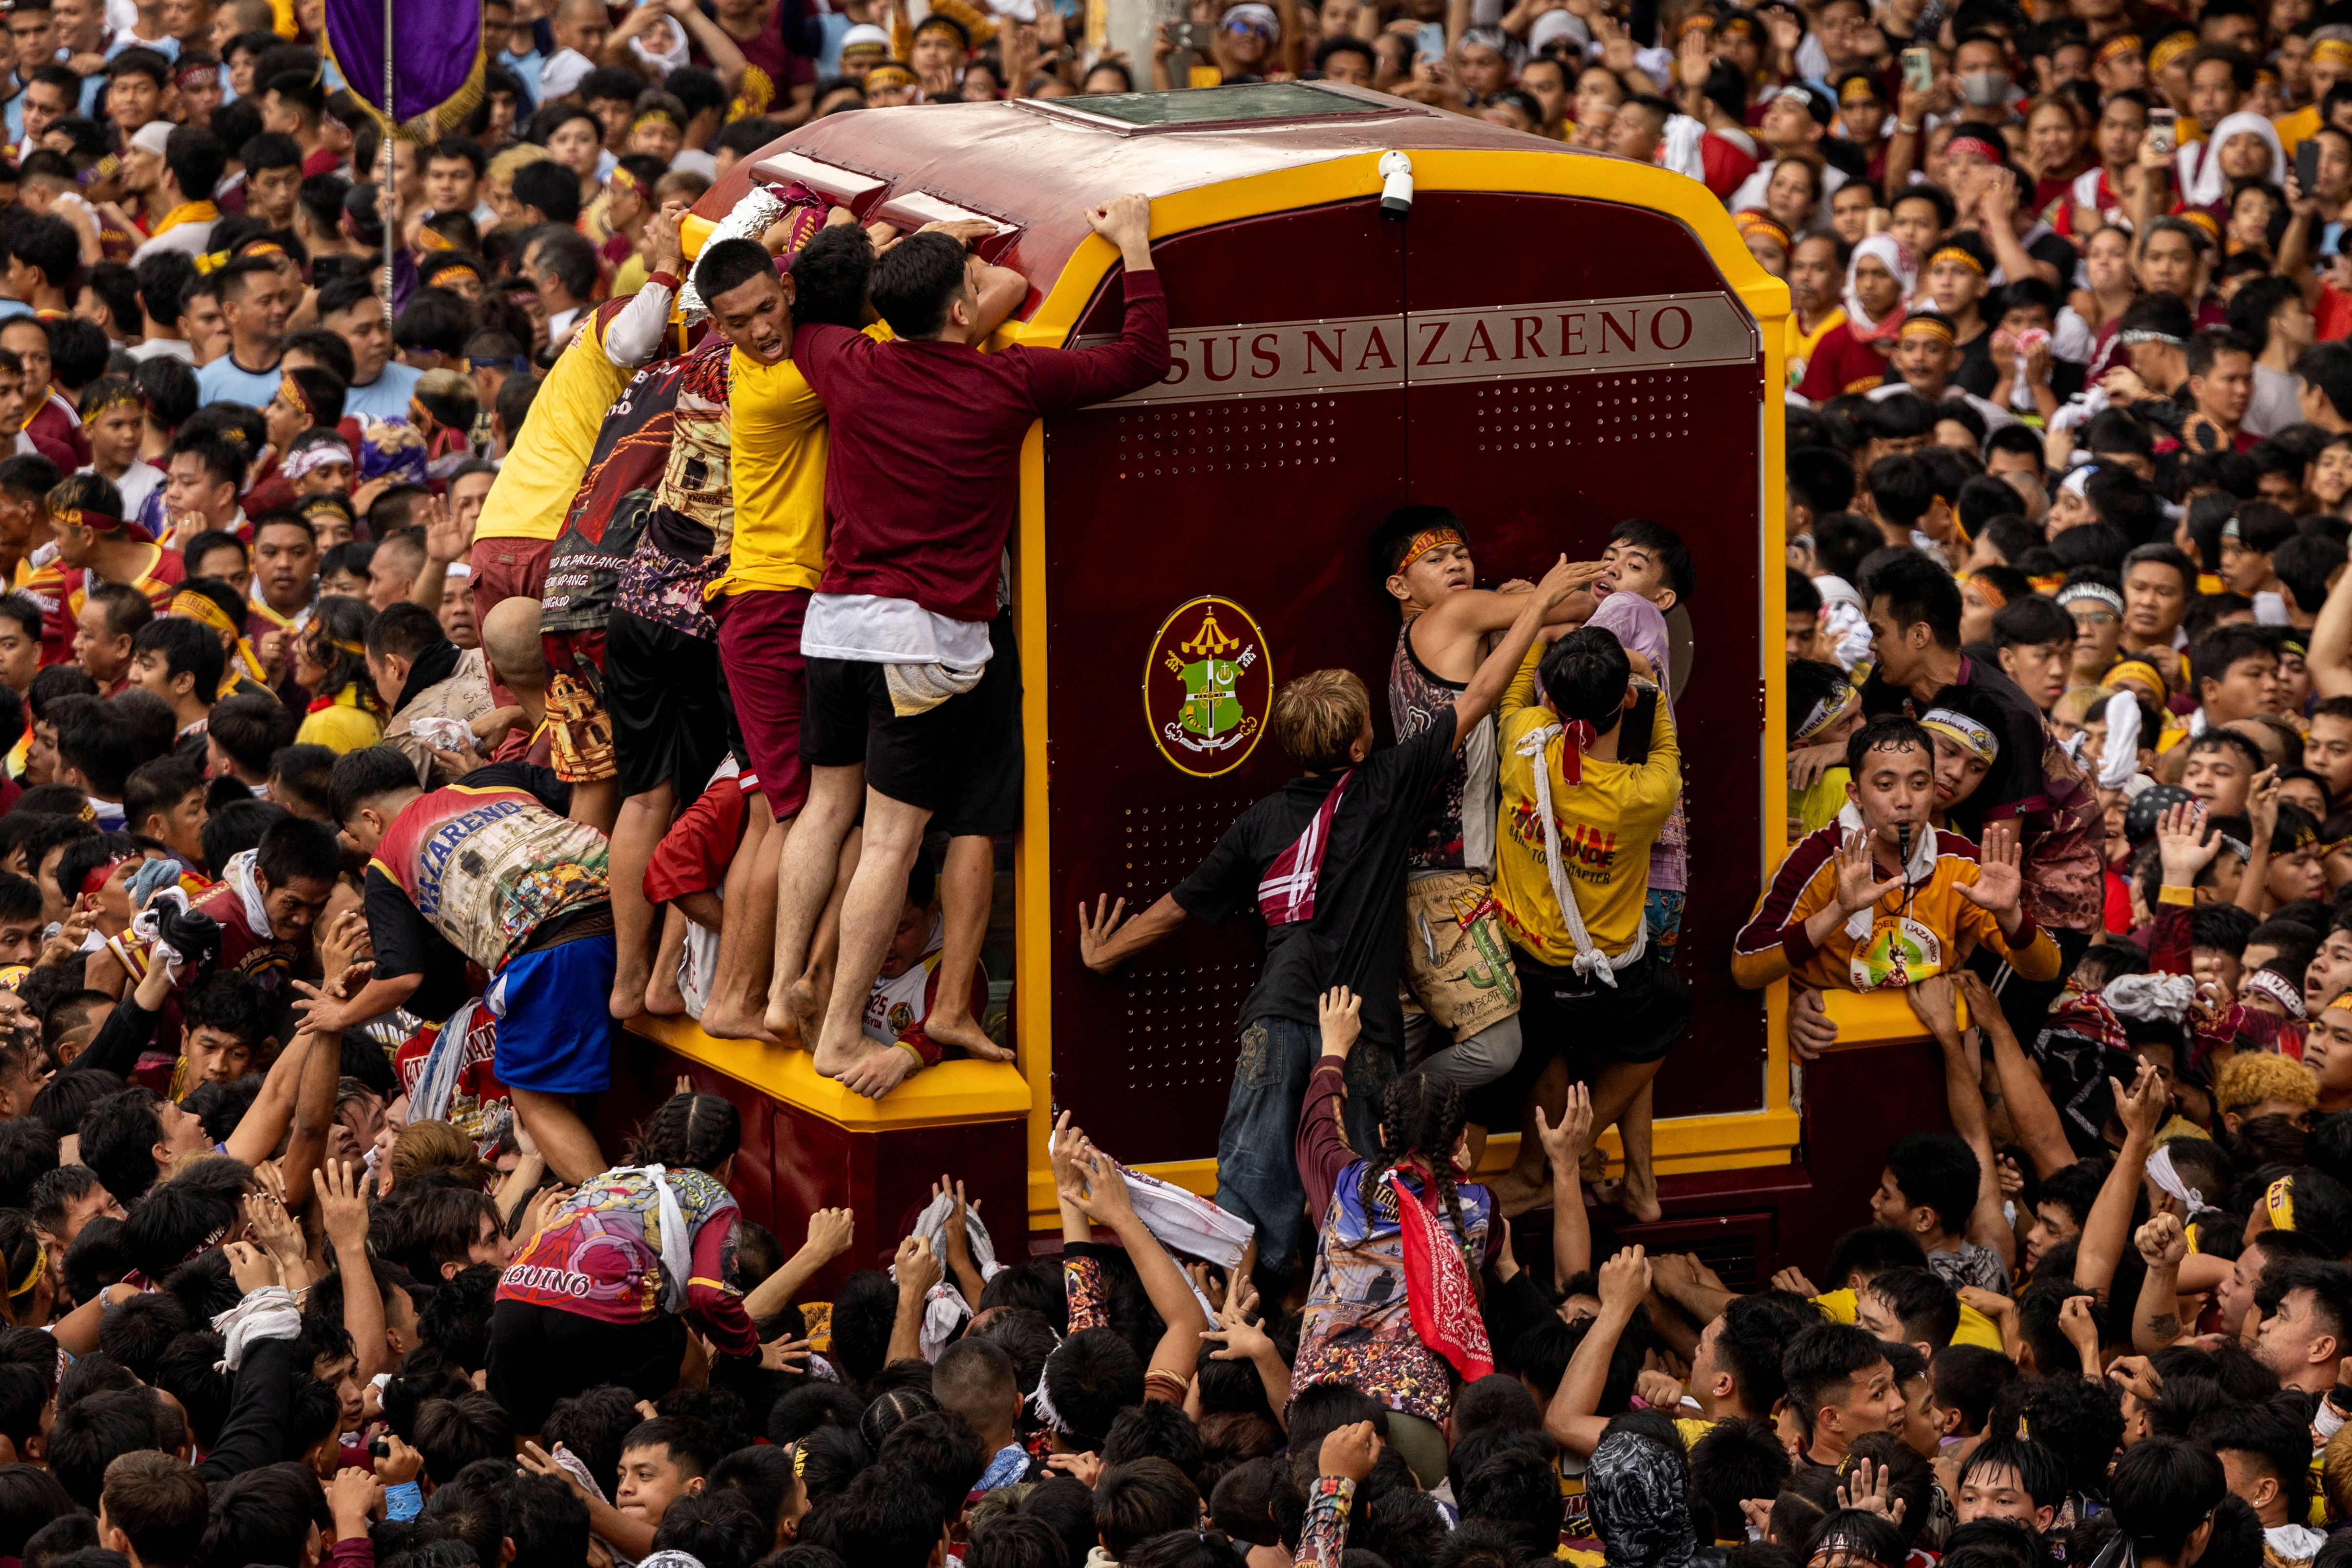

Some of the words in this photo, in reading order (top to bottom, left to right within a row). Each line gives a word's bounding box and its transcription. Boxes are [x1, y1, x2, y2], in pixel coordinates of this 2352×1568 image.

[1160, 334, 1281, 384] SUS
[1303, 306, 1693, 375] NAZARENO
[570, 553, 628, 569] DAKILANG
[557, 574, 589, 586] UPANG
[419, 800, 523, 915] NAZARENO
[1877, 920, 1896, 931] DEL
[1906, 923, 1937, 962] NAZARENO
[499, 1264, 590, 1296] AQUINO
